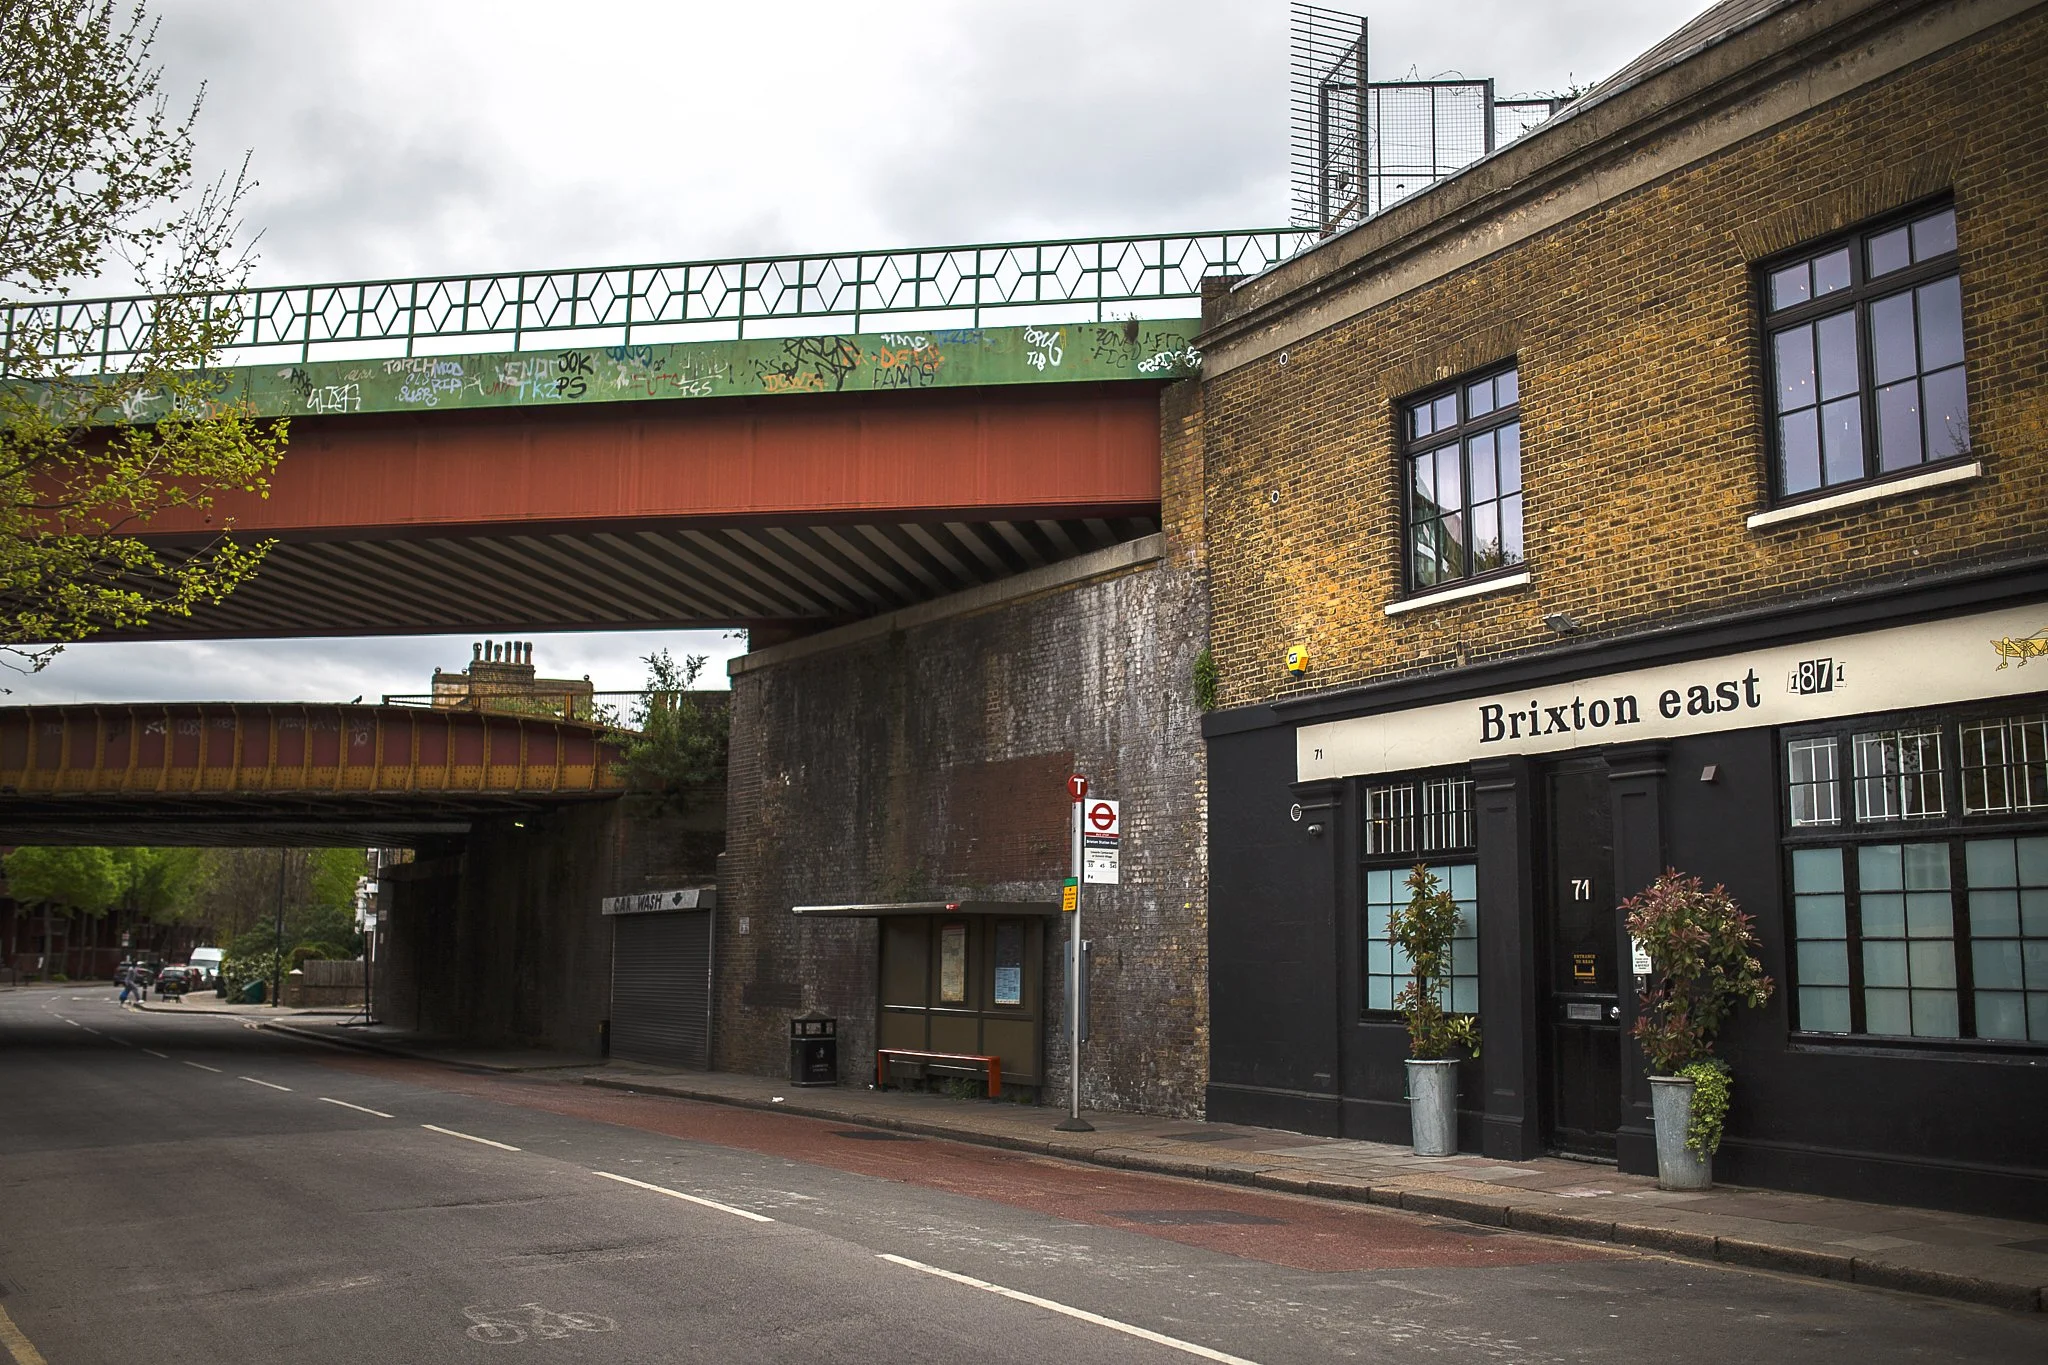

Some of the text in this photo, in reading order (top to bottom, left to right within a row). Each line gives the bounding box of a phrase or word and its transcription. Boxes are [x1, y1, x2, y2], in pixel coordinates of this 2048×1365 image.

[1479, 659, 1845, 743] Brixton east 1871
[1314, 748, 1323, 760] 71
[1073, 777, 1085, 795] T
[1571, 879, 1590, 900] 71
[637, 893, 663, 912] WASH
